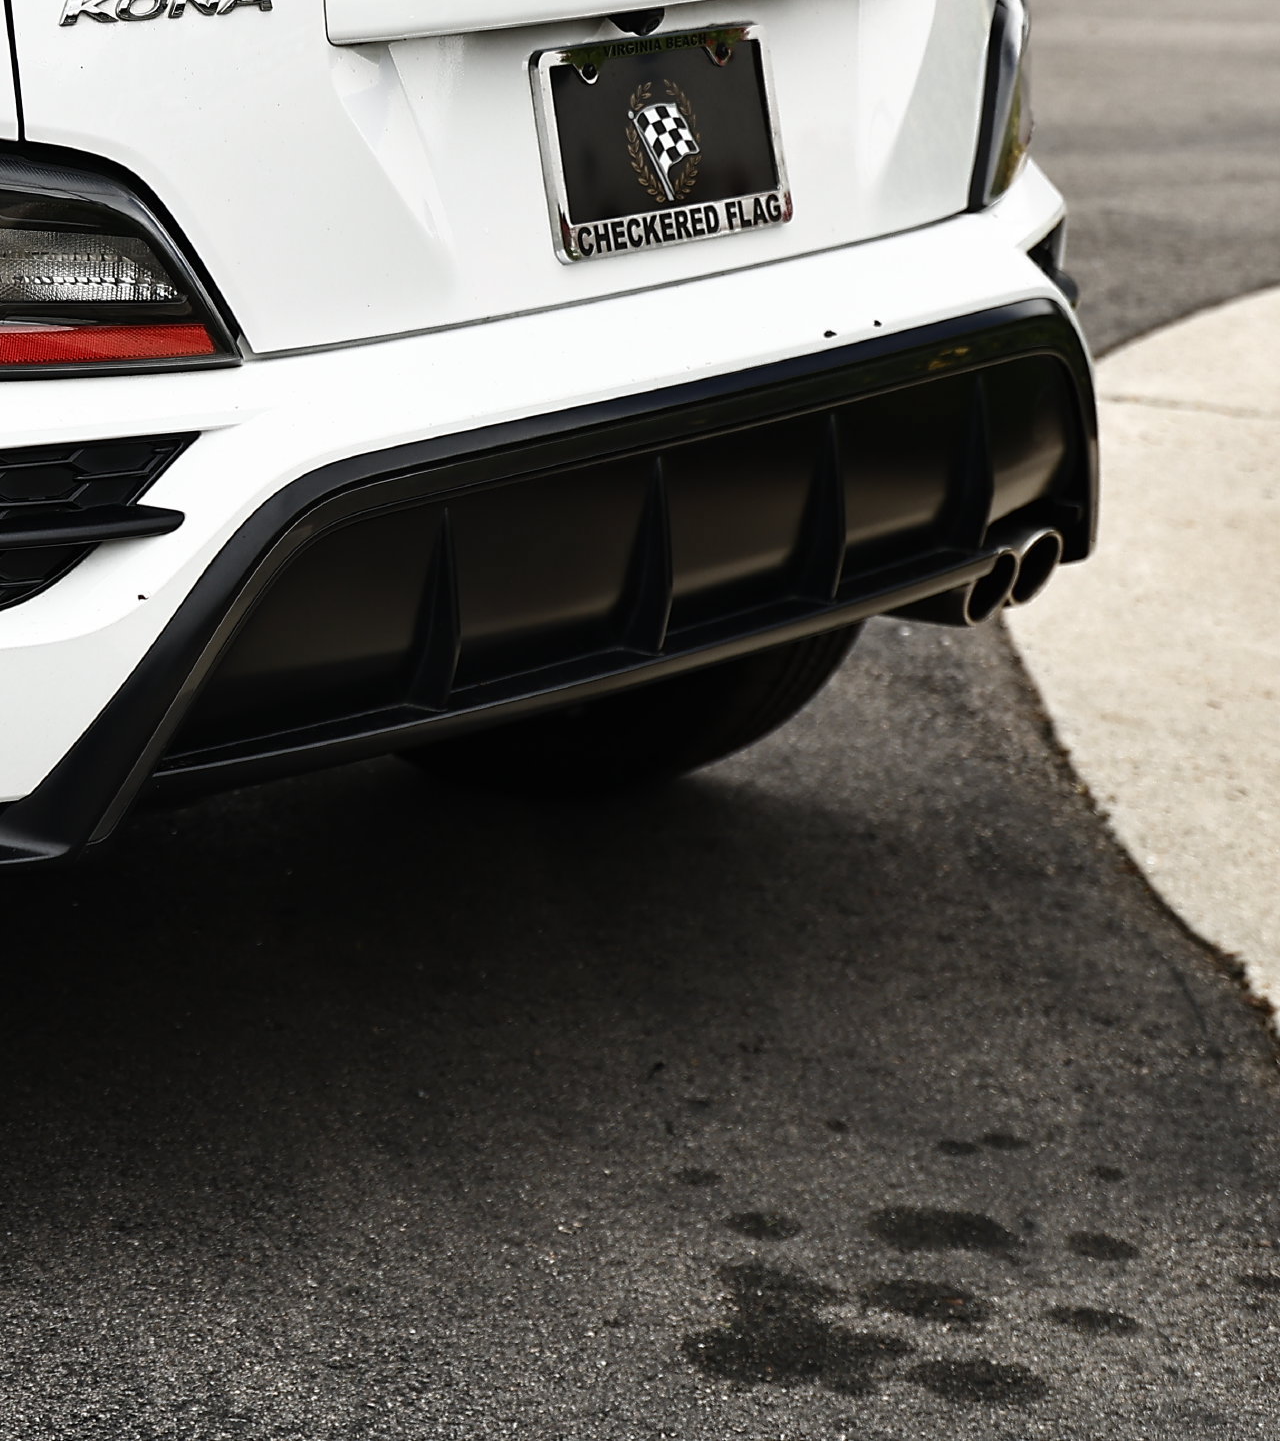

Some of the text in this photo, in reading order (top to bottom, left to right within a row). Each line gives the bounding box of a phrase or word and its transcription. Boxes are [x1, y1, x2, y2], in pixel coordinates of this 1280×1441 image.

[603, 32, 708, 58] VIRGINIA BEACH
[576, 193, 783, 257] CHECKERED FLAG
